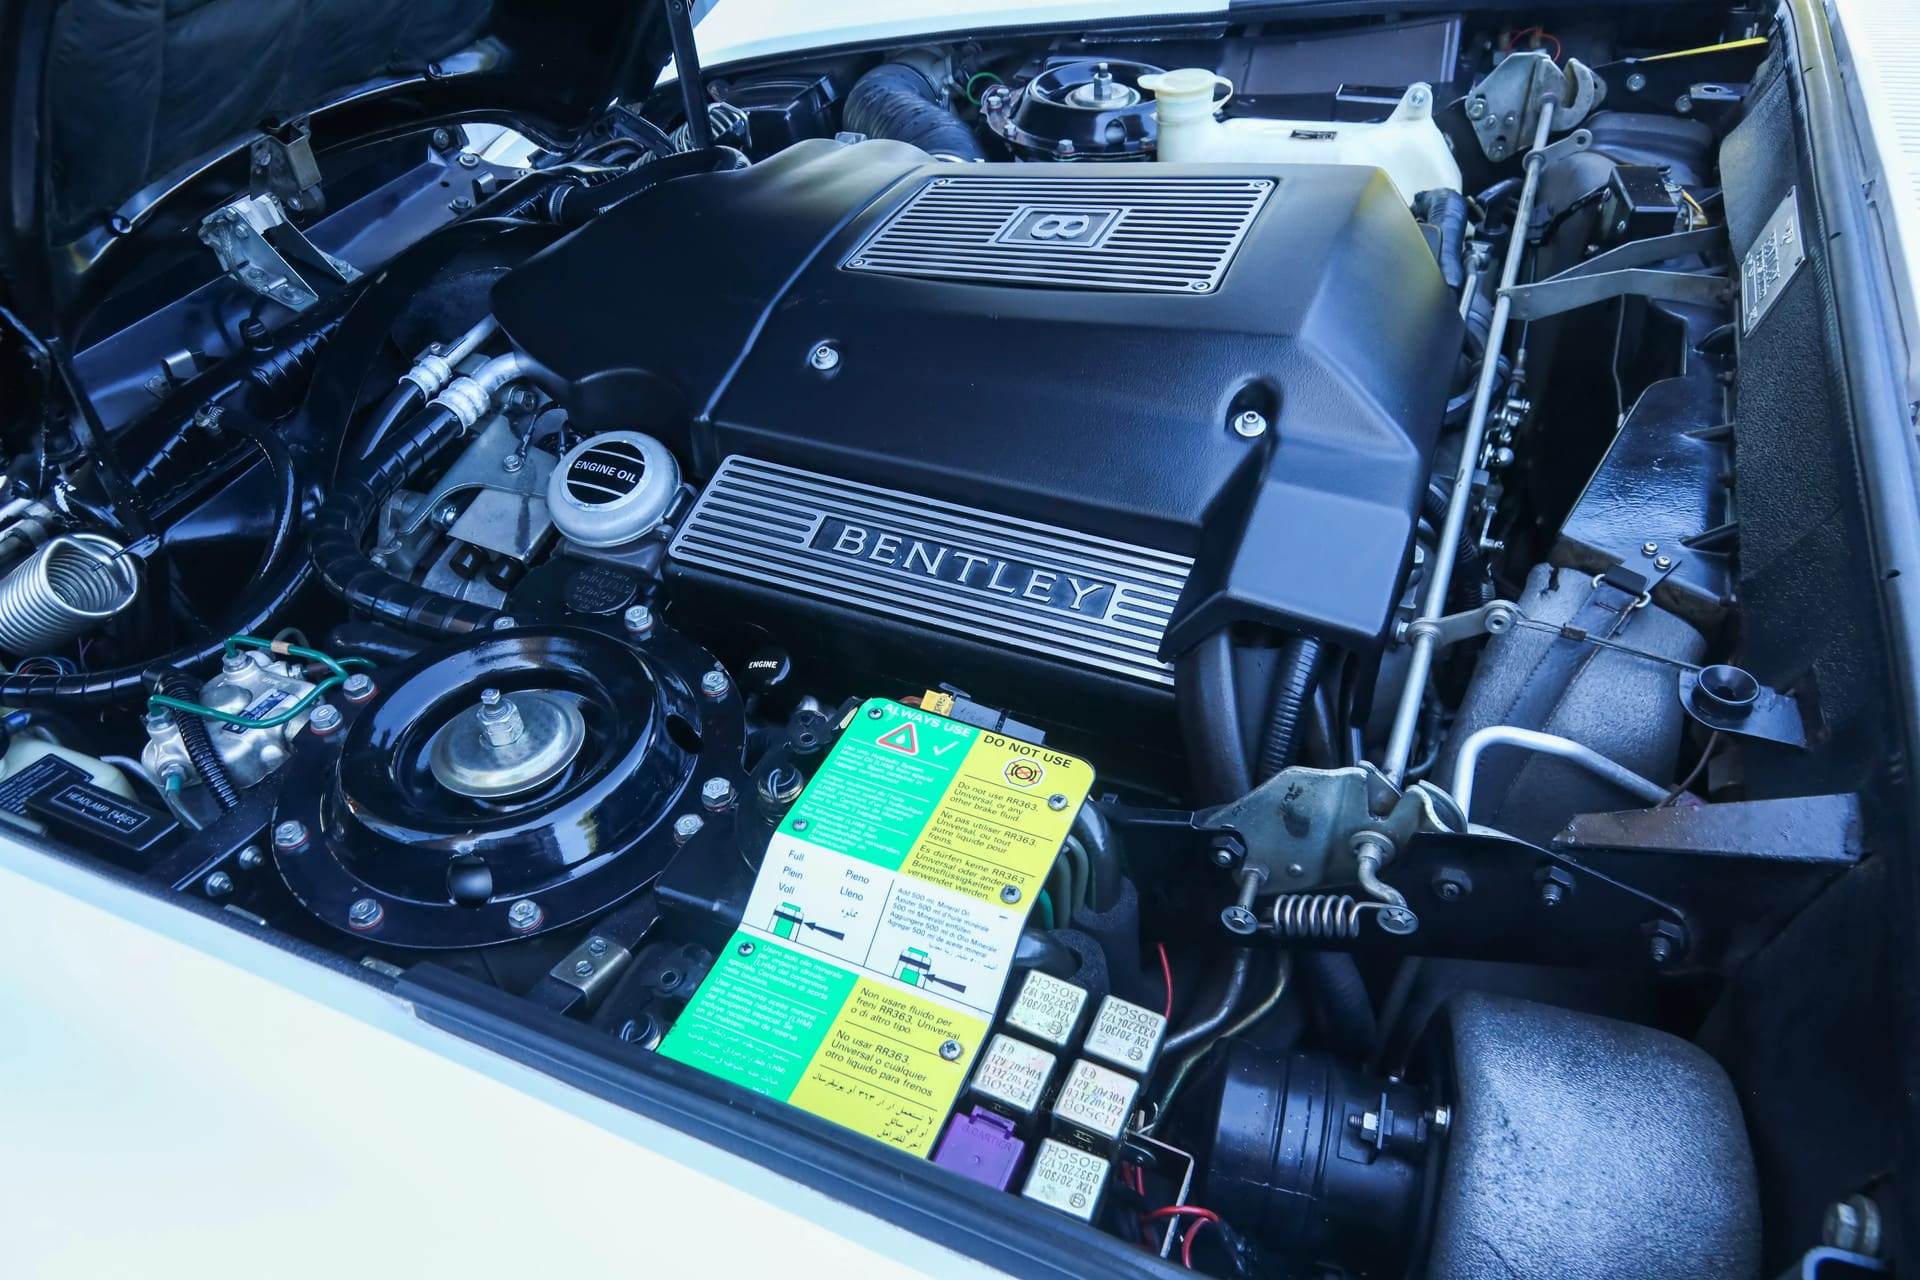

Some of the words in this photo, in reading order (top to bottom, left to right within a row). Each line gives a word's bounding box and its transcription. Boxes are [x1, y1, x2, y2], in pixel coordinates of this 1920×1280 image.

[574, 460, 617, 476] ENGINE
[617, 469, 637, 484] OIL
[831, 523, 1104, 611] BENTLEY
[748, 660, 779, 669] ENGINE
[883, 702, 941, 728] ALWAYS
[943, 721, 973, 738] USE
[983, 735, 1005, 747] DO
[1008, 741, 1041, 760] NOT
[1042, 753, 1073, 769] USE
[957, 781, 970, 791] Do
[972, 787, 986, 795] not
[65, 792, 110, 815] HEADLAMP
[949, 797, 972, 807] other
[973, 803, 997, 815] brake
[1007, 807, 1024, 815] any
[940, 810, 953, 819] Ne
[954, 817, 970, 825] pas
[972, 822, 1001, 834] utiliser
[931, 826, 954, 836] autre
[956, 832, 985, 847] liquide
[986, 844, 1007, 854] pour
[979, 833, 991, 841] ou
[994, 837, 1011, 847] tout
[788, 849, 805, 861] Full
[920, 844, 931, 853] Es
[965, 860, 989, 872] keine
[782, 866, 803, 880] Plein
[845, 869, 870, 884] Pieno
[908, 869, 953, 888] verwendet
[915, 852, 957, 870] Universal
[958, 868, 978, 878] oder
[979, 876, 1017, 889] ander
[779, 882, 795, 895] Voll
[840, 886, 863, 901] Lleno
[911, 892, 925, 901] 500
[893, 902, 906, 912] 500
[918, 902, 932, 912] 500
[912, 926, 926, 936] 500
[945, 940, 963, 950] aceite
[925, 923, 939, 932] 500
[1029, 974, 1081, 1002] BOSCH
[850, 1006, 858, 1015] o
[858, 1008, 870, 1018] di
[870, 1014, 891, 1027] altro
[855, 997, 877, 1010] freni
[916, 1018, 961, 1041] Universal
[860, 987, 880, 1000] Non
[881, 996, 907, 1011] usare
[909, 1004, 935, 1022] fluido
[936, 1016, 953, 1029] per
[1107, 1001, 1160, 1029] BOSCH
[836, 1029, 851, 1042] No
[852, 1038, 873, 1050] usar
[830, 1039, 874, 1062] Universal
[883, 1060, 928, 1083] cualquier
[825, 1050, 845, 1063] otro
[878, 1071, 901, 1085] para
[902, 1078, 934, 1098] frenos
[980, 1075, 1033, 1104] BOSCH
[1062, 1101, 1117, 1127] BOSCH
[1046, 1144, 1101, 1173] BOSCH
